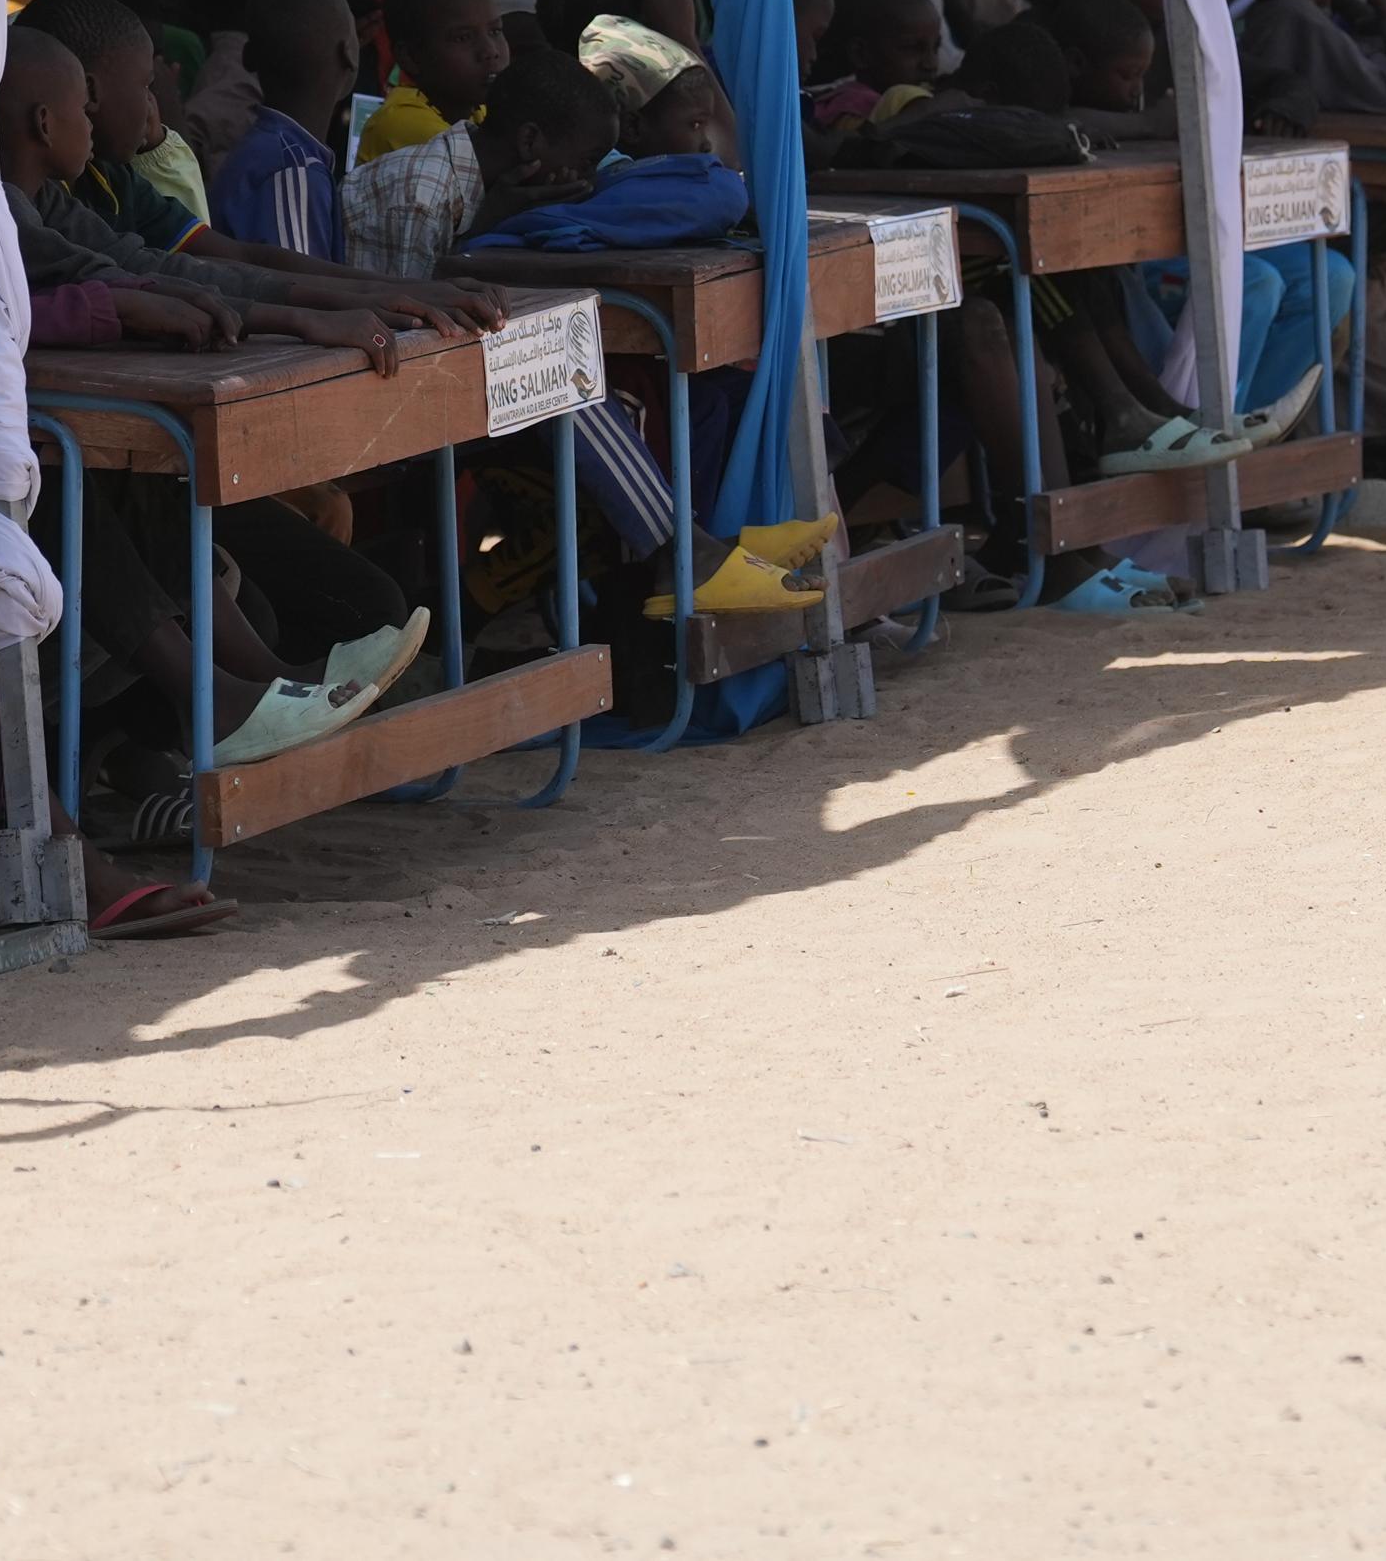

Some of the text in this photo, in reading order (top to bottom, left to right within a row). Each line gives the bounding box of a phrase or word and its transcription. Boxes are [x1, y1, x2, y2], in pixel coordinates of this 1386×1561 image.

[1272, 199, 1317, 224] SALMAN
[491, 363, 568, 409] KING SALMAN
